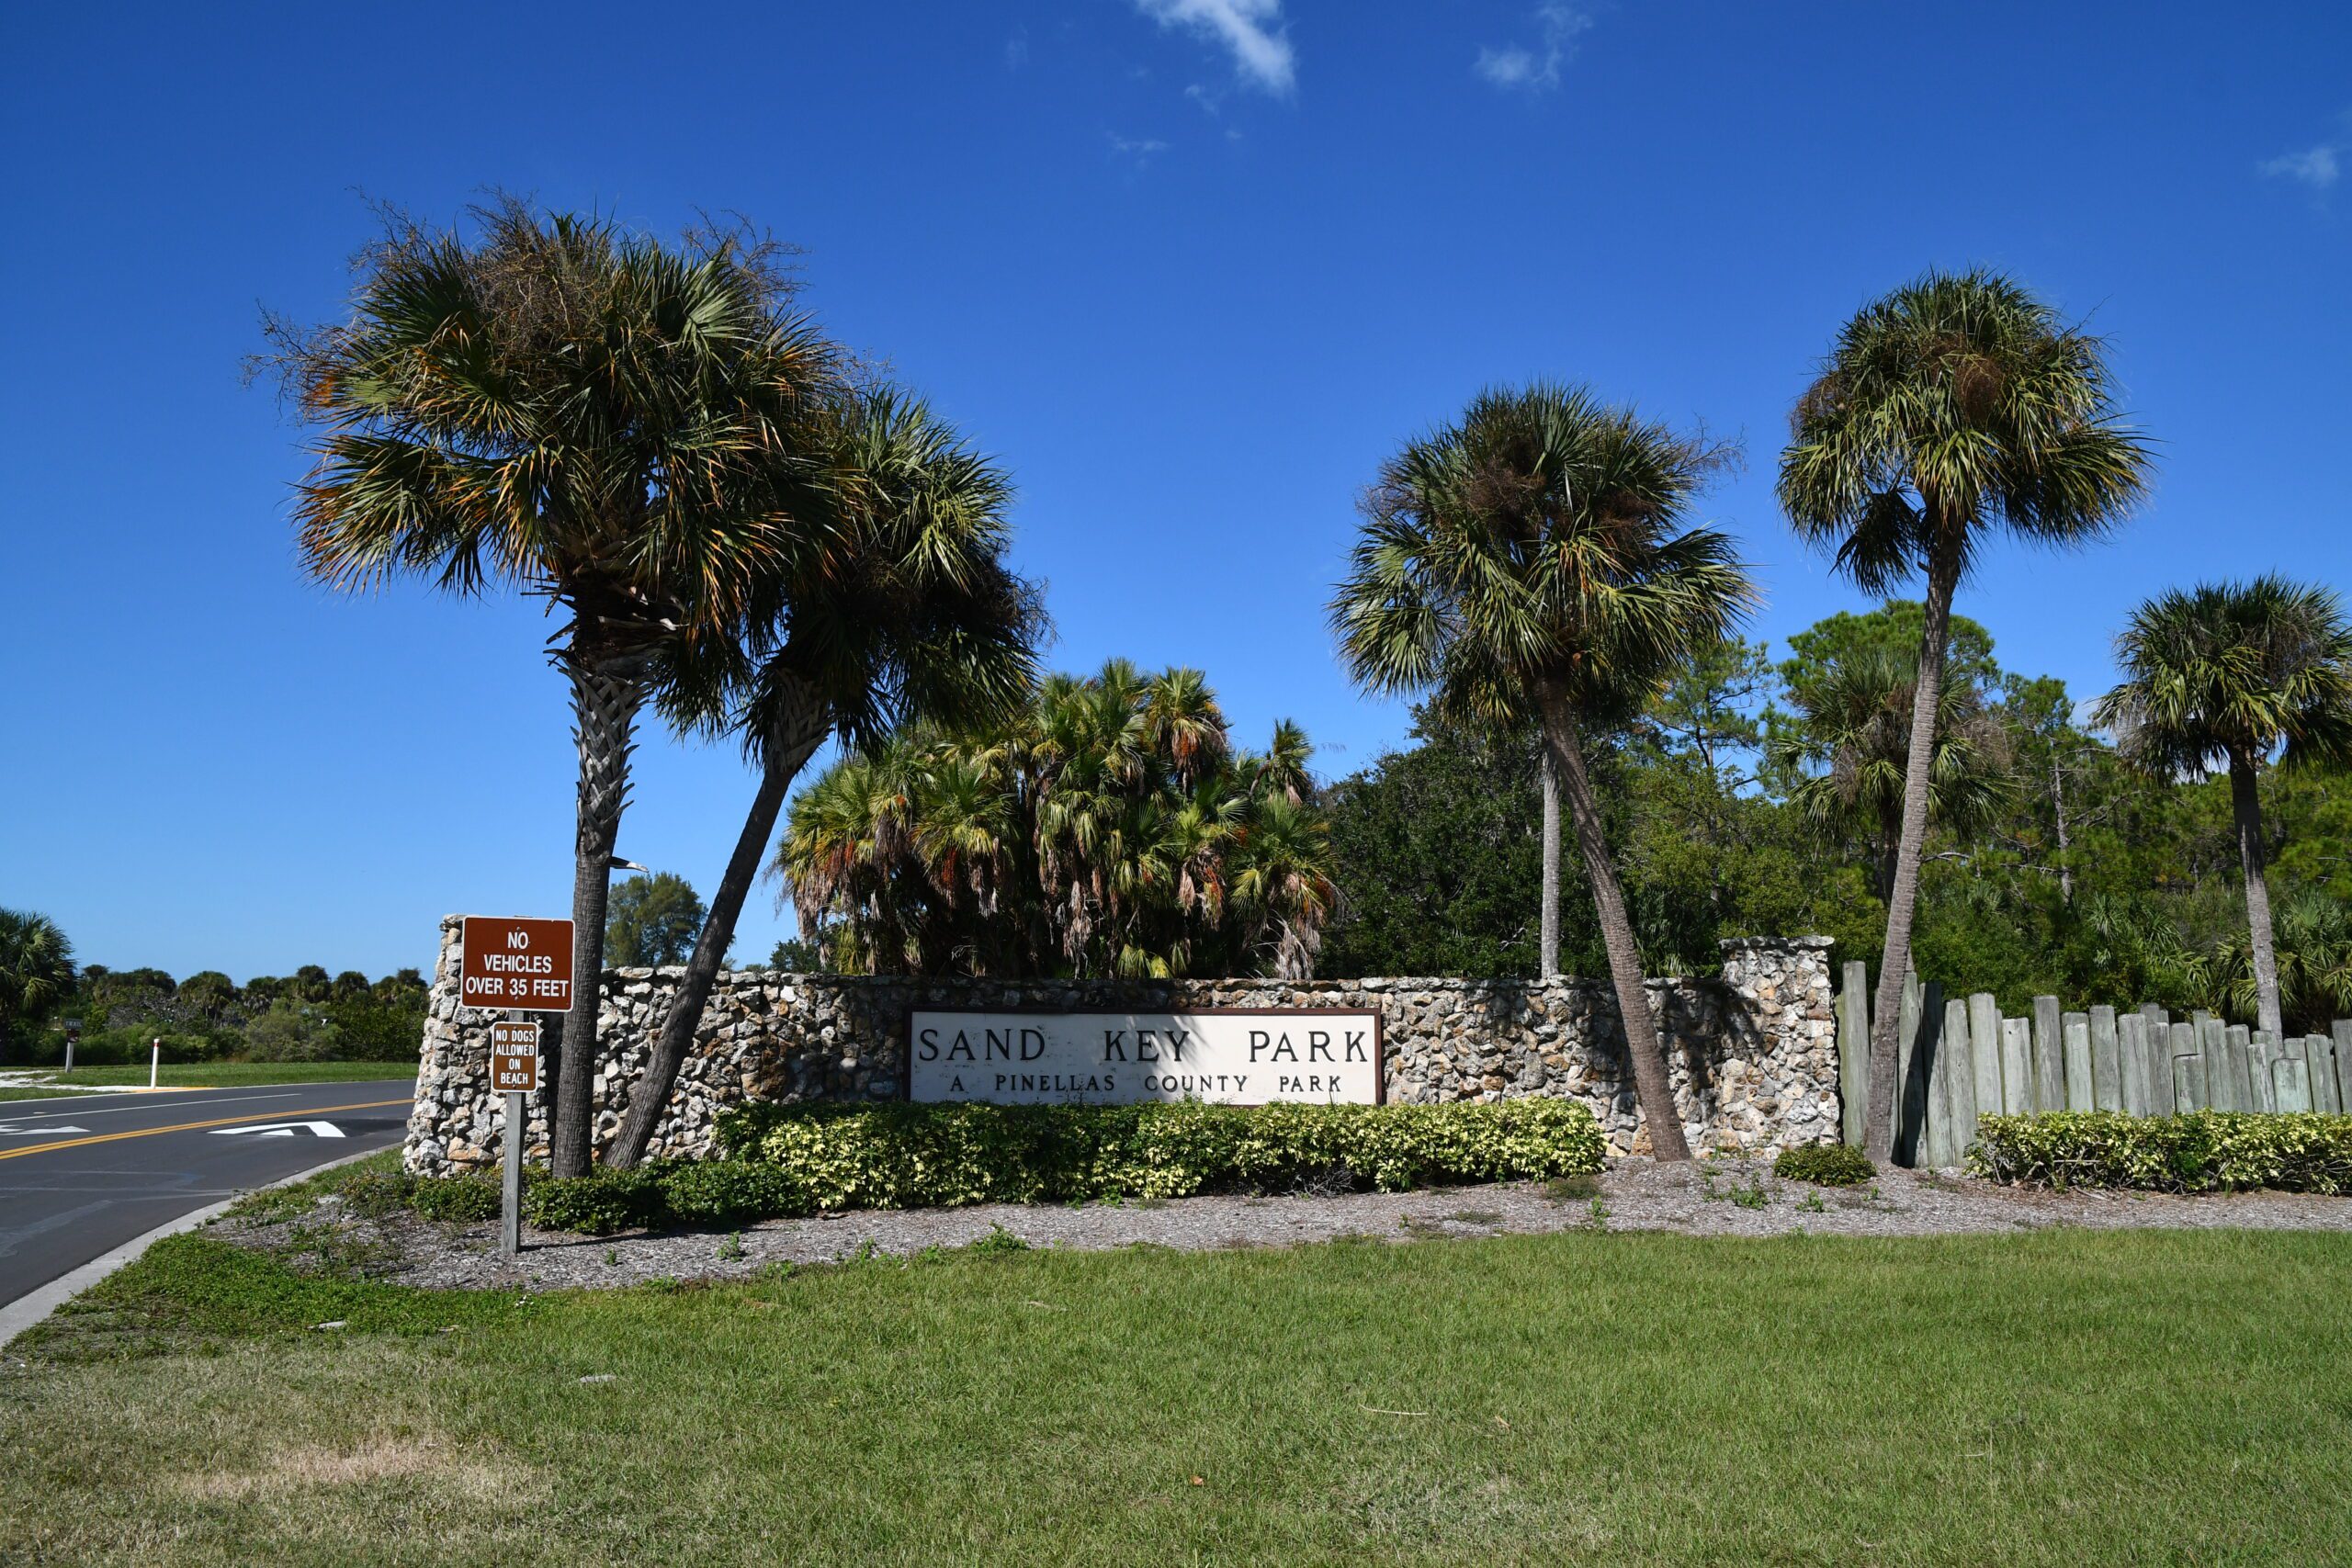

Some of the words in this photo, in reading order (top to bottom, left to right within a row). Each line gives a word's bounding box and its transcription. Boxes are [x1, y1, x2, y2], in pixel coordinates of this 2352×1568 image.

[508, 931, 528, 949] NO
[483, 954, 552, 973] VEHICLES
[466, 976, 503, 995] OVER
[509, 979, 527, 996] 35
[533, 980, 569, 997] FEET
[495, 1030, 507, 1041] NO
[511, 1030, 534, 1042] DOGS
[495, 1044, 534, 1056] ALLOWED
[919, 1029, 1046, 1062] SAND
[1104, 1030, 1191, 1062] KEY
[1250, 1031, 1368, 1063] PARK
[508, 1058, 520, 1070] ON
[500, 1073, 528, 1085] BEACH
[950, 1075, 964, 1091] A
[996, 1075, 1114, 1091] PINELLAS
[1145, 1075, 1248, 1092] COUNTY
[1279, 1076, 1342, 1092] PARK
